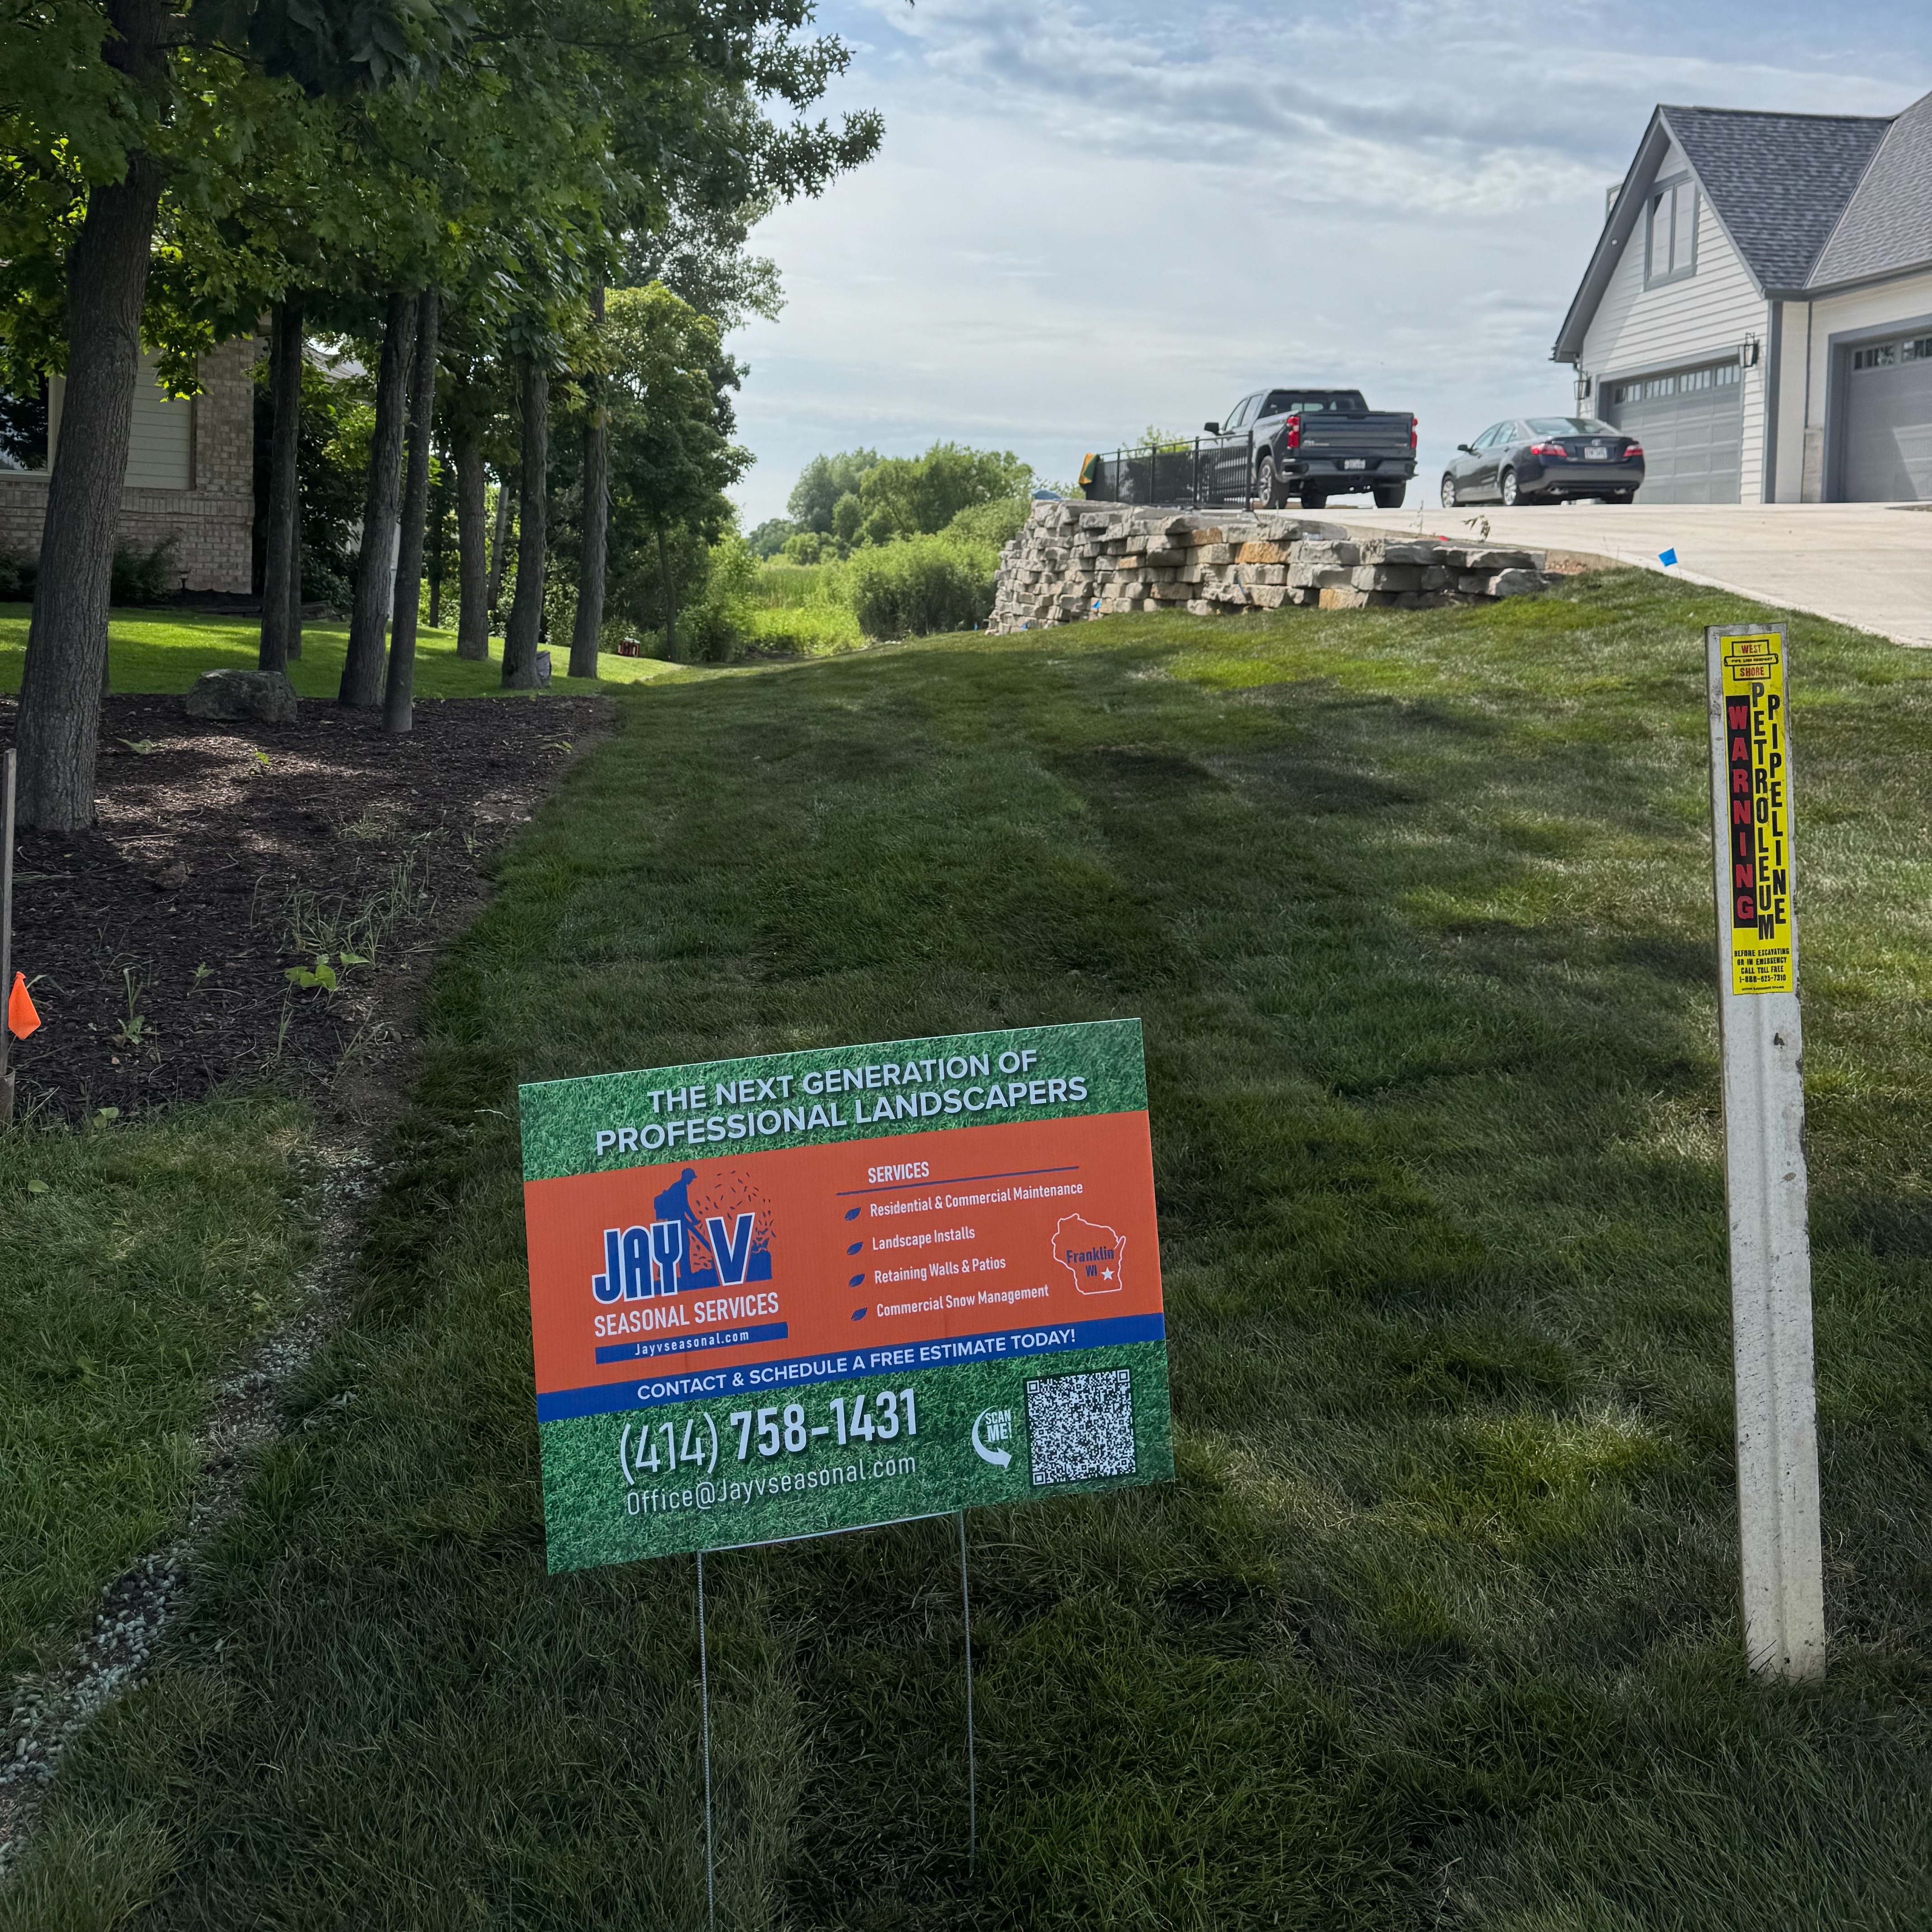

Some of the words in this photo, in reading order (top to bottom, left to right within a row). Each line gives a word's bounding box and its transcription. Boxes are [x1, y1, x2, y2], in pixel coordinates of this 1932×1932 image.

[1741, 644, 1761, 653] WEST
[1740, 667, 1764, 676] SHORE
[1728, 706, 1753, 920] WARNING
[1752, 682, 1774, 940] PETROLEUM
[1767, 695, 1786, 924] PIPELINE
[1758, 948, 1789, 956] EXCAVATING
[647, 1086, 706, 1113] THE
[716, 1075, 793, 1105] NEXT
[803, 1054, 989, 1095] GENERATION
[998, 1049, 1037, 1074] OF
[596, 1103, 846, 1155] PROFESSIONAL
[855, 1076, 1087, 1123] LANDSCAPERS
[868, 1161, 929, 1184] SERVICES
[870, 1197, 932, 1218] Residential
[935, 1196, 943, 1209] &
[945, 1189, 1011, 1207] Commercial
[1013, 1183, 1083, 1201] Maintenance
[872, 1233, 932, 1251] Landscape
[934, 1226, 975, 1243] Installs
[1066, 1246, 1114, 1264] Franklin
[592, 1220, 682, 1304] JAY
[705, 1212, 755, 1286] V
[874, 1268, 927, 1284] Retaining
[929, 1261, 959, 1276] Walls
[961, 1260, 970, 1273] &
[972, 1257, 1006, 1272] Patios
[1086, 1265, 1098, 1278] WI
[594, 1305, 690, 1337] SEASONAL
[694, 1292, 779, 1324] SERVICES
[877, 1297, 943, 1317] Commercial
[946, 1292, 975, 1308] Snow
[978, 1284, 1049, 1305] Management
[635, 1330, 749, 1357] Jayvseasonal.com
[637, 1375, 727, 1400] CONTACT
[732, 1372, 744, 1386] &
[750, 1357, 847, 1384] SCHEDULE
[852, 1356, 865, 1371] A
[870, 1348, 914, 1368] FREE
[920, 1337, 1006, 1362] ESTIMATE
[1011, 1329, 1076, 1348] TODAY!
[985, 1410, 1011, 1425] SCAN
[987, 1422, 1012, 1442] ME!
[620, 1412, 718, 1486] (414)
[730, 1388, 916, 1460] 758-1431
[627, 1456, 915, 1515] Office@Jayvseasonal.com
